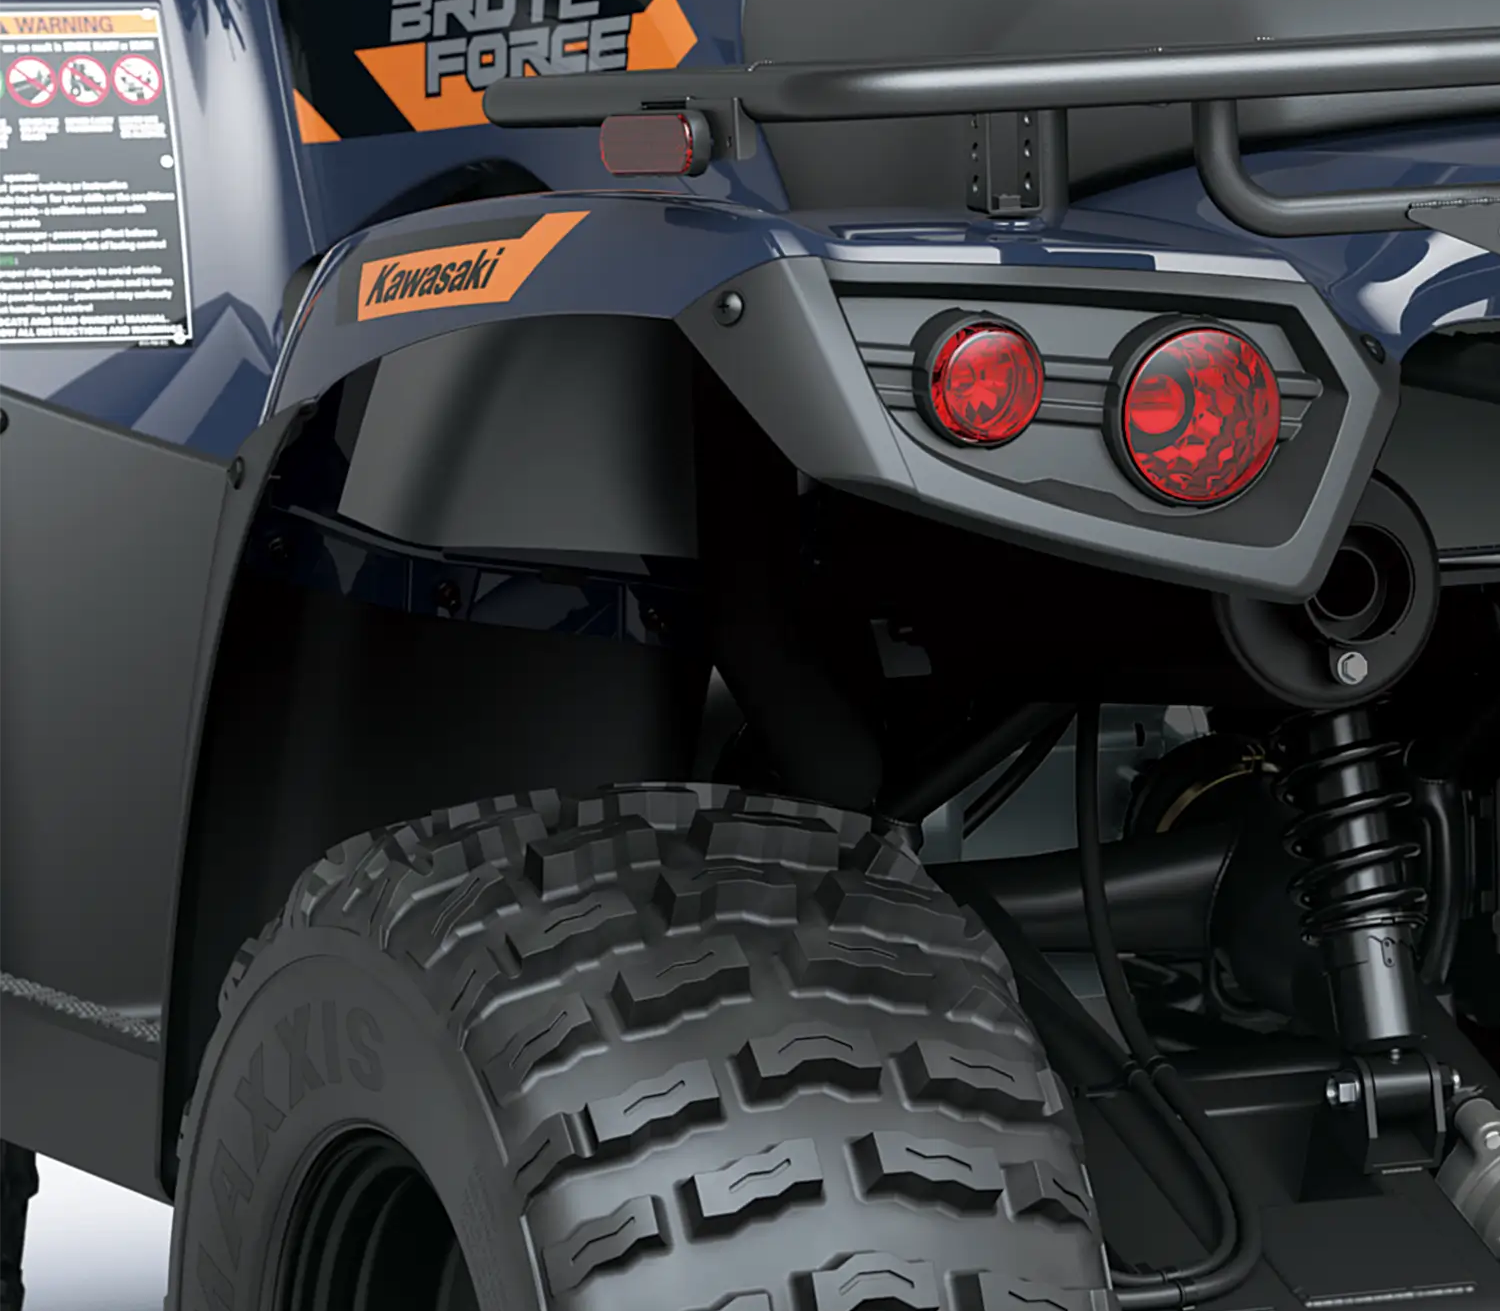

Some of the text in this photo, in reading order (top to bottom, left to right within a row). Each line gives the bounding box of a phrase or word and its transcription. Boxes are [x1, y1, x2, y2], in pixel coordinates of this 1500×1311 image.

[14, 16, 114, 34] WARNING
[425, 15, 631, 97] FORCE
[365, 247, 505, 306] Kawasaki
